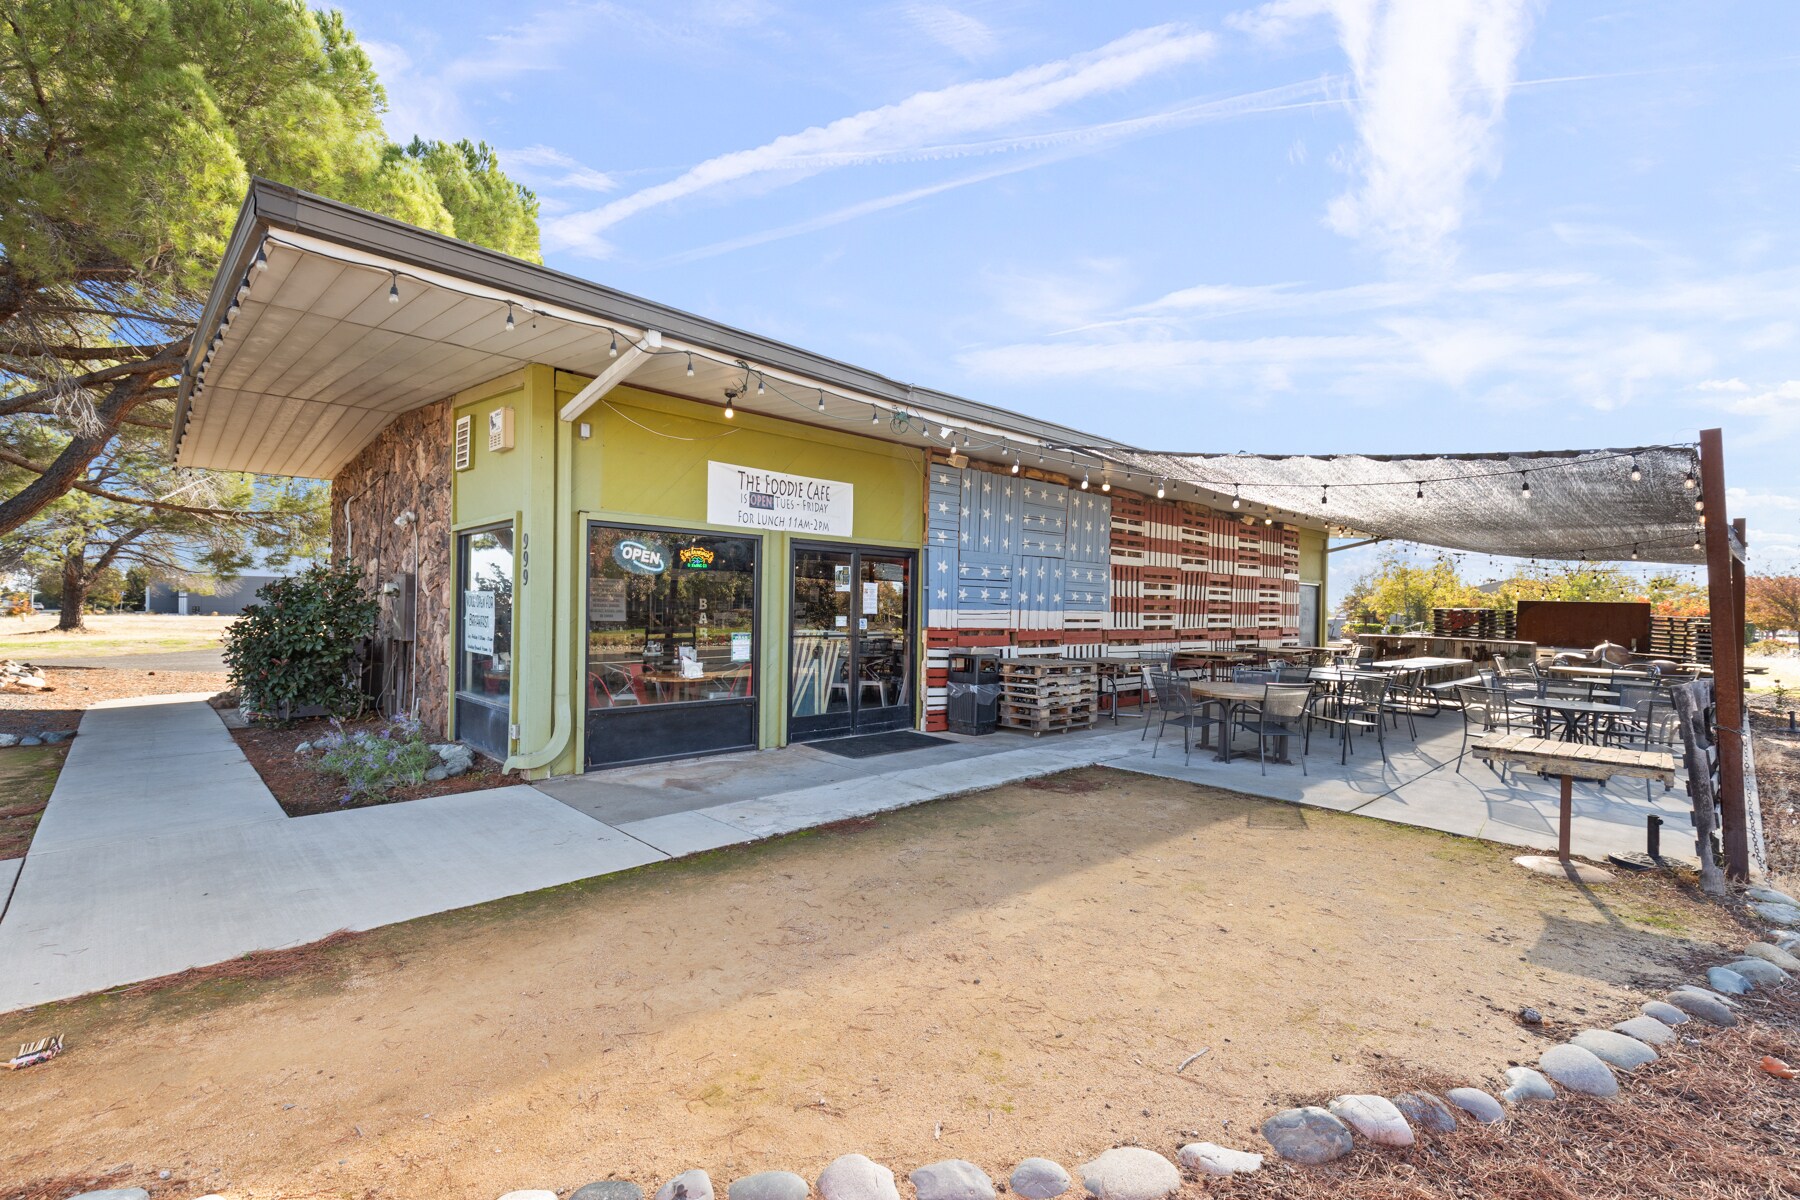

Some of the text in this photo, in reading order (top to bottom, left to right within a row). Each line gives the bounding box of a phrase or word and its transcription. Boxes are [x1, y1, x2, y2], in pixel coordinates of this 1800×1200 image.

[738, 470, 831, 502] THE FOODIE CAFE
[740, 493, 748, 504] IS
[750, 494, 773, 508] OPEN
[775, 496, 795, 510] TUES
[802, 499, 829, 514] FRIDAY
[738, 510, 830, 532] FOR LUNCH 11AM-2PM
[622, 546, 661, 565] OPEN
[699, 598, 708, 639] BAR
